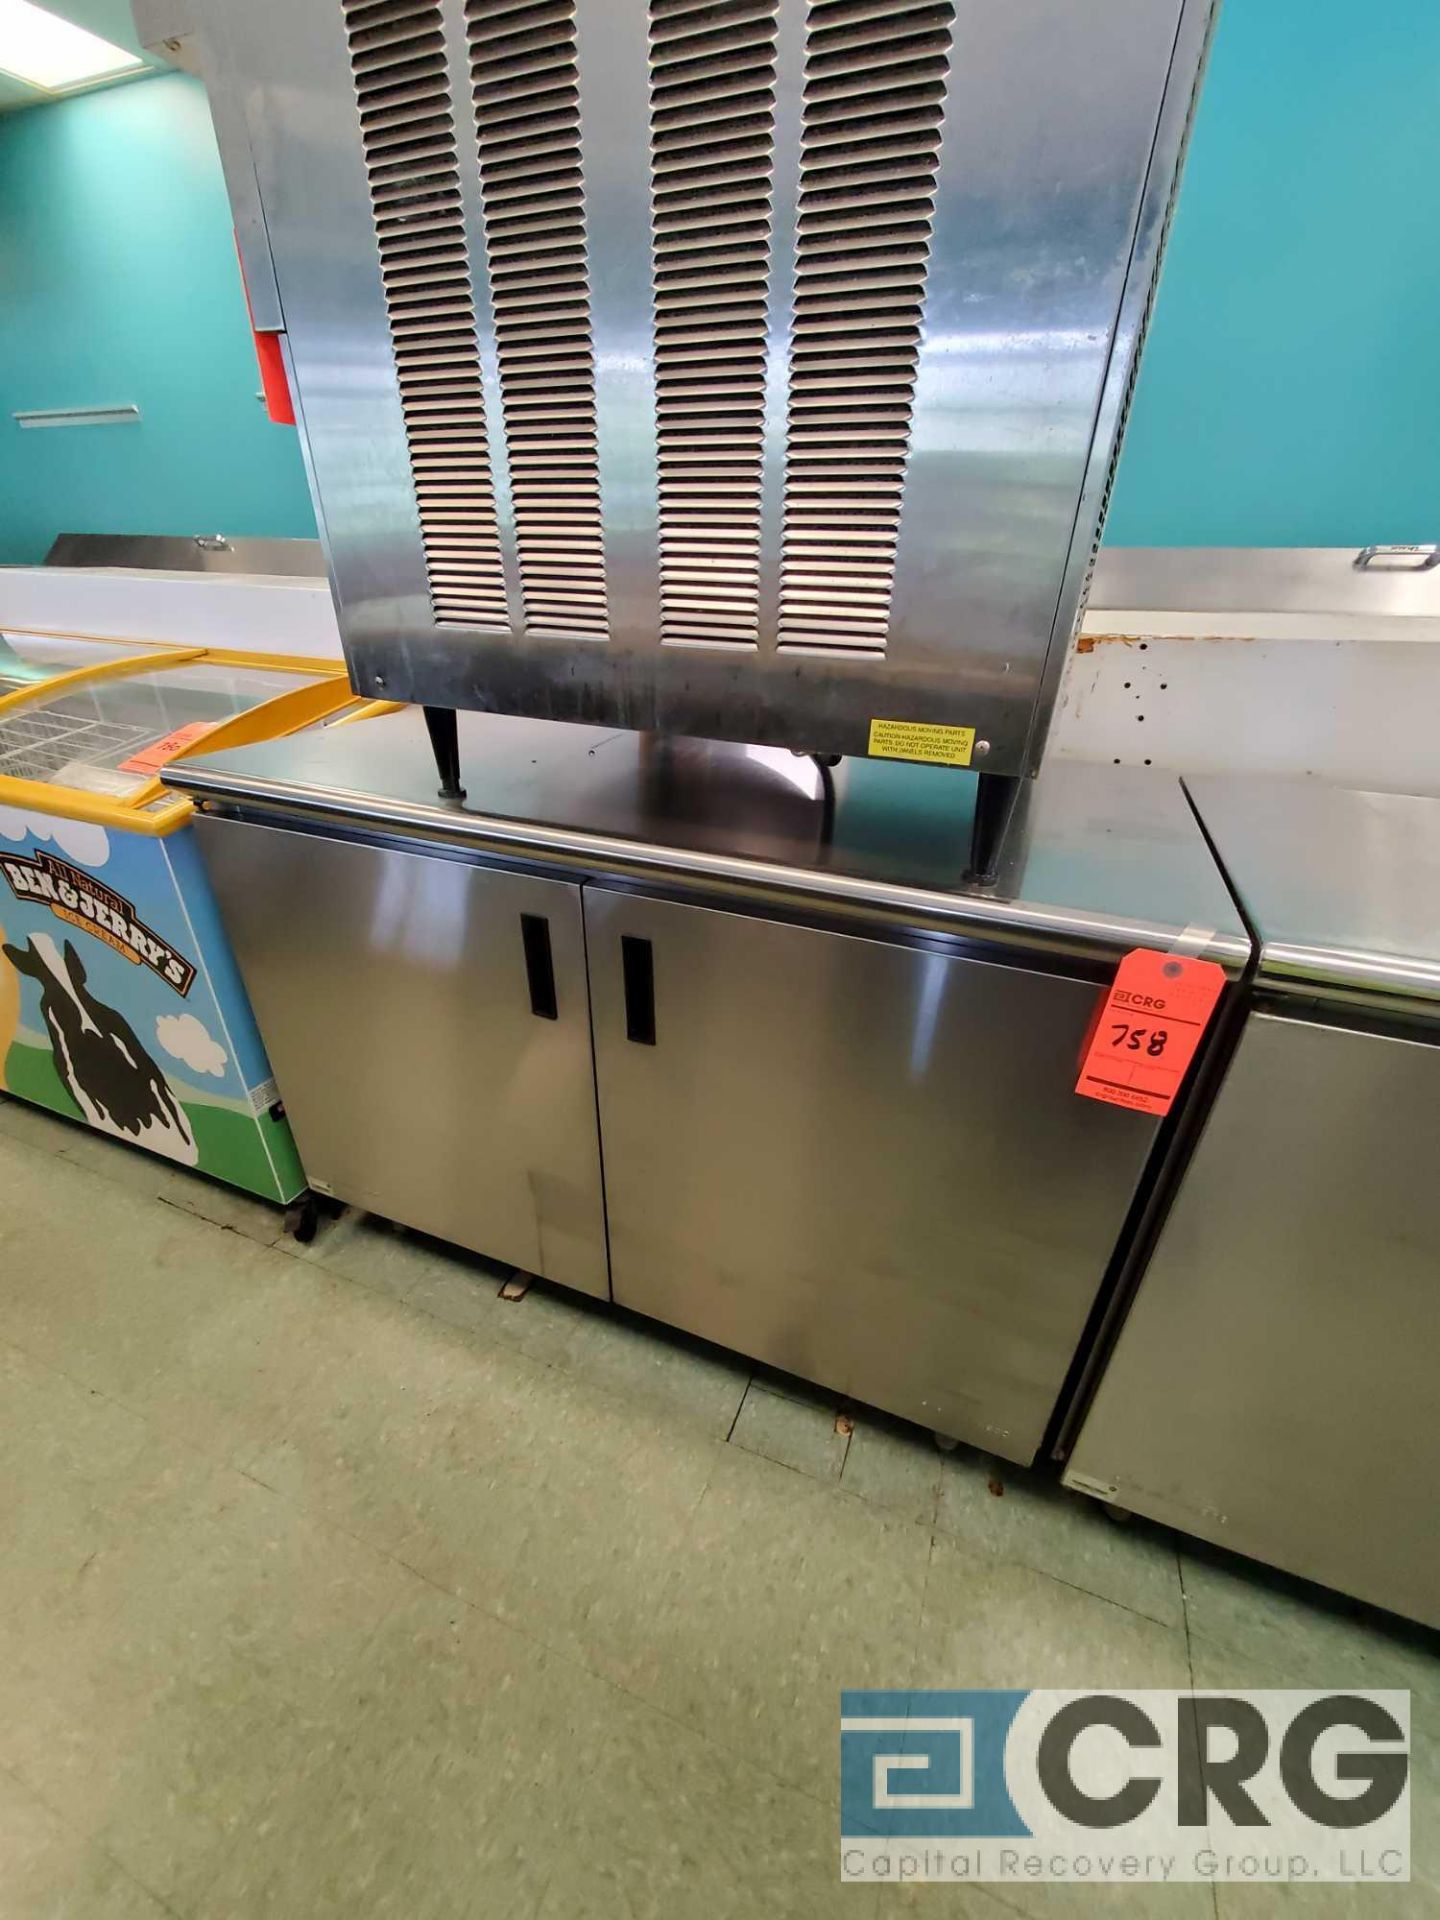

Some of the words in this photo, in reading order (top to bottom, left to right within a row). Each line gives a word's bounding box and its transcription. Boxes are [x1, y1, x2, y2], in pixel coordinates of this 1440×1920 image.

[918, 726, 943, 735] MOVING
[945, 729, 966, 737] PARTS
[906, 741, 919, 749] NOT
[920, 742, 951, 751] OPERATE
[943, 738, 968, 747] MOVING
[881, 745, 898, 753] WITH
[924, 750, 956, 759] REMOVED
[48, 859, 67, 882] All
[71, 871, 125, 914] Natural
[5, 862, 60, 903] BEN
[58, 880, 79, 909] &
[77, 889, 186, 984] JERRY'S
[85, 921, 127, 954] CREAM
[1131, 993, 1167, 1010] CRG
[1111, 1023, 1169, 1057] 758
